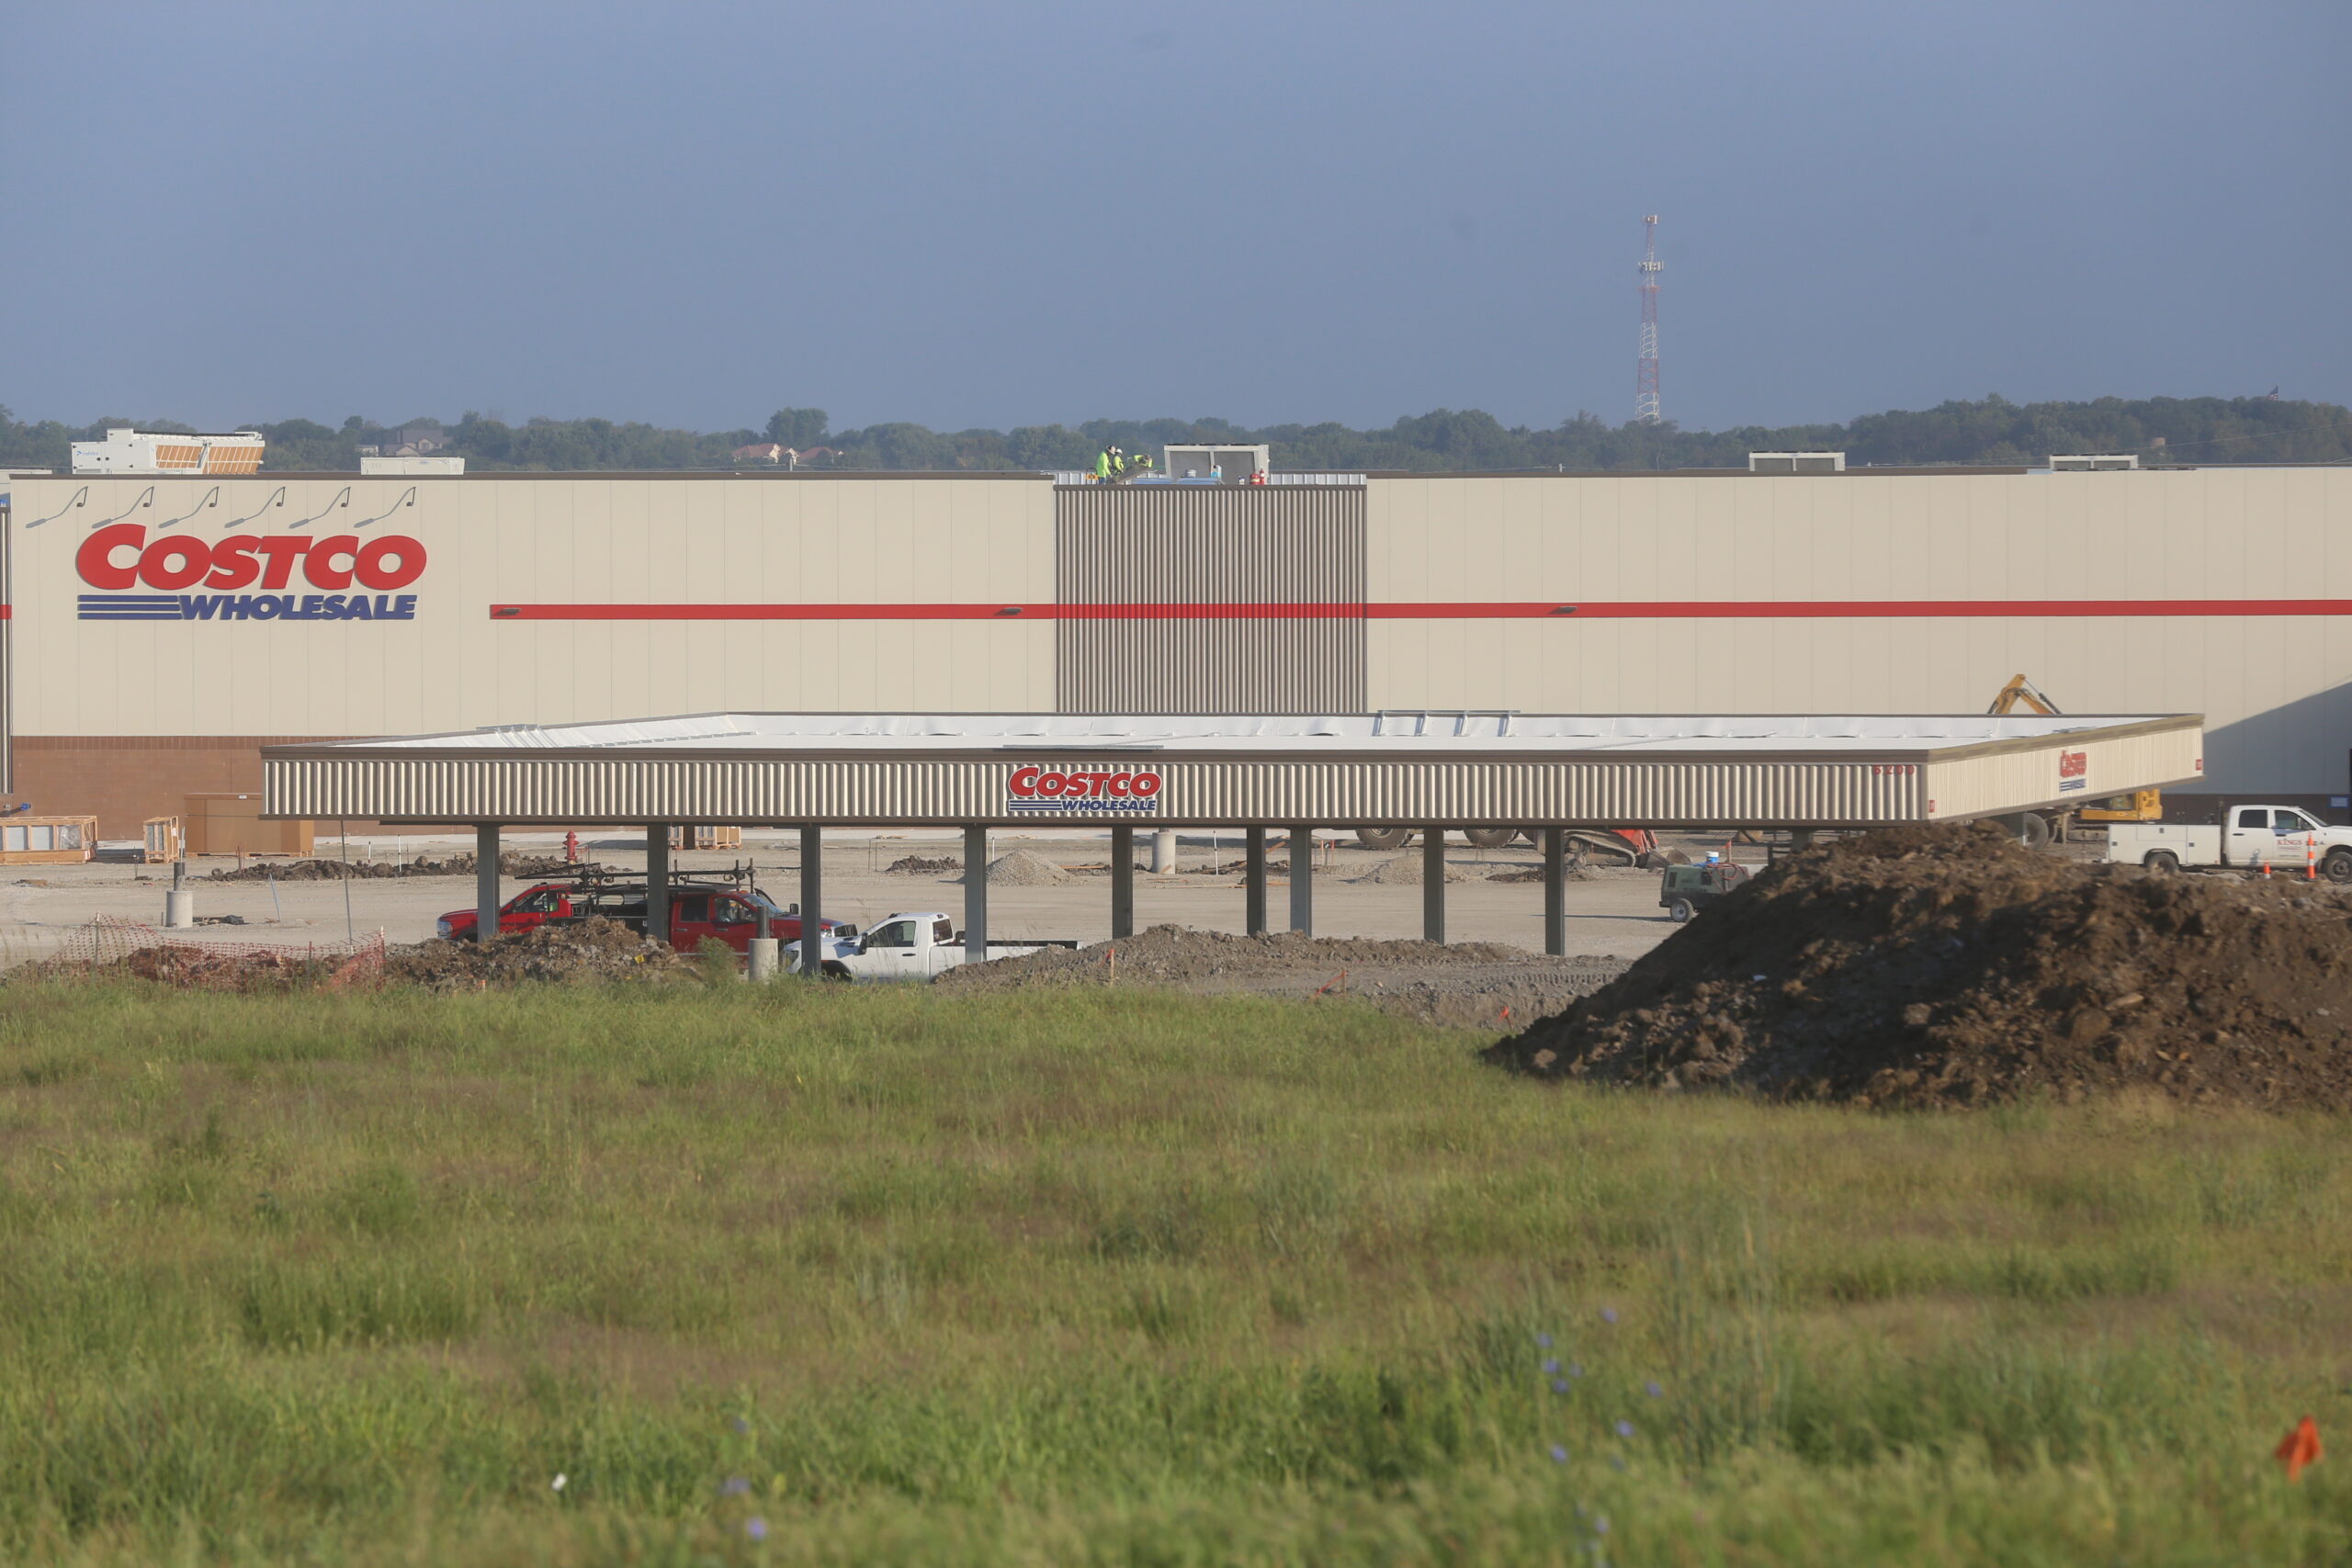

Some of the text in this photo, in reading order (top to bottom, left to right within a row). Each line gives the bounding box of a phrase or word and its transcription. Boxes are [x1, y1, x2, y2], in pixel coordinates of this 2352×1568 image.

[75, 523, 427, 590] COSTCO
[177, 594, 417, 620] WHOLESALE
[1009, 766, 1162, 797] COSTCO
[1061, 799, 1157, 811] WHOLESALE
